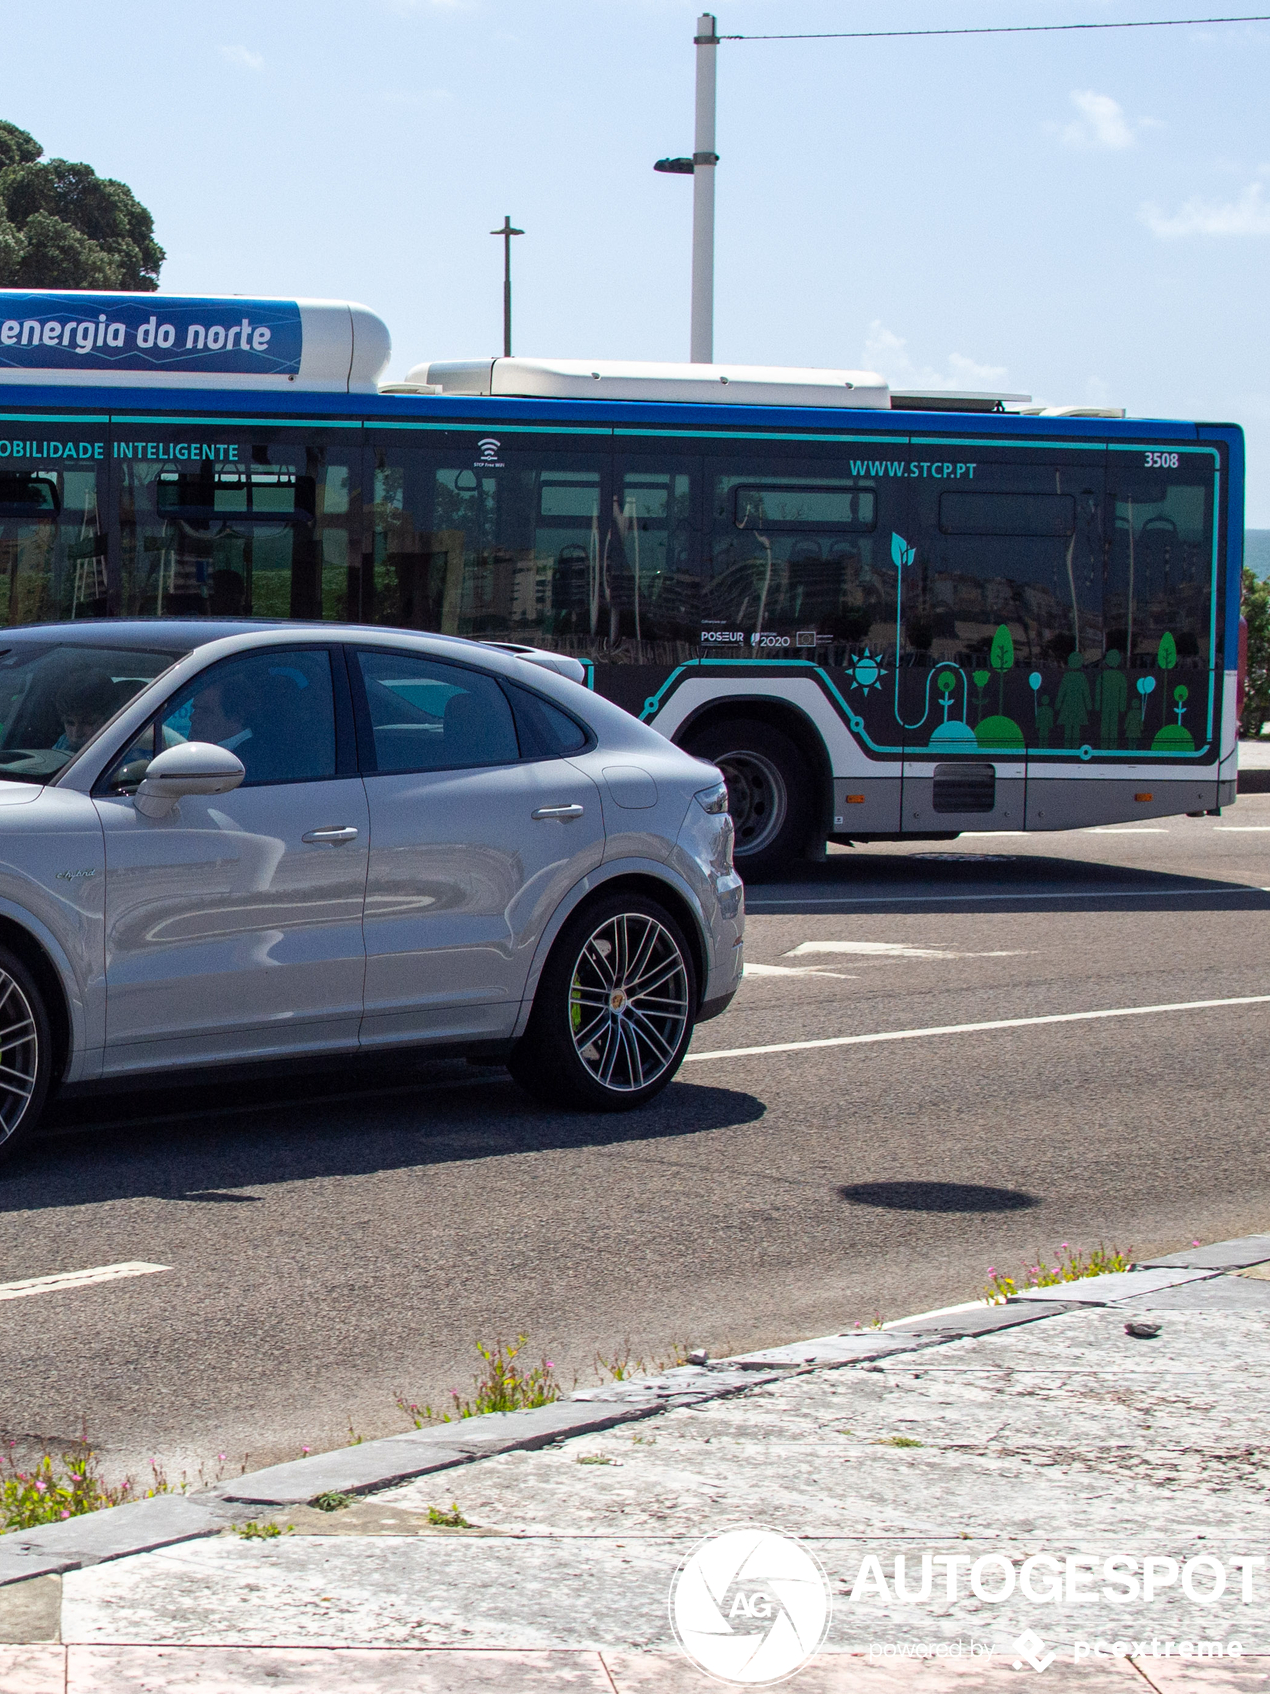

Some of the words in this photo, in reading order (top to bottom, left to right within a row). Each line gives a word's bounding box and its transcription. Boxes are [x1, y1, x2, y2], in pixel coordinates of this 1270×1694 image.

[0, 314, 127, 354] energia
[136, 316, 176, 349] do
[186, 318, 271, 351] norte
[113, 442, 238, 461] INTELIGENTE
[1144, 452, 1179, 469] 3508
[849, 460, 977, 479] WWW.STCP.PT
[701, 632, 744, 642] POSEUR
[760, 637, 790, 647] 2020
